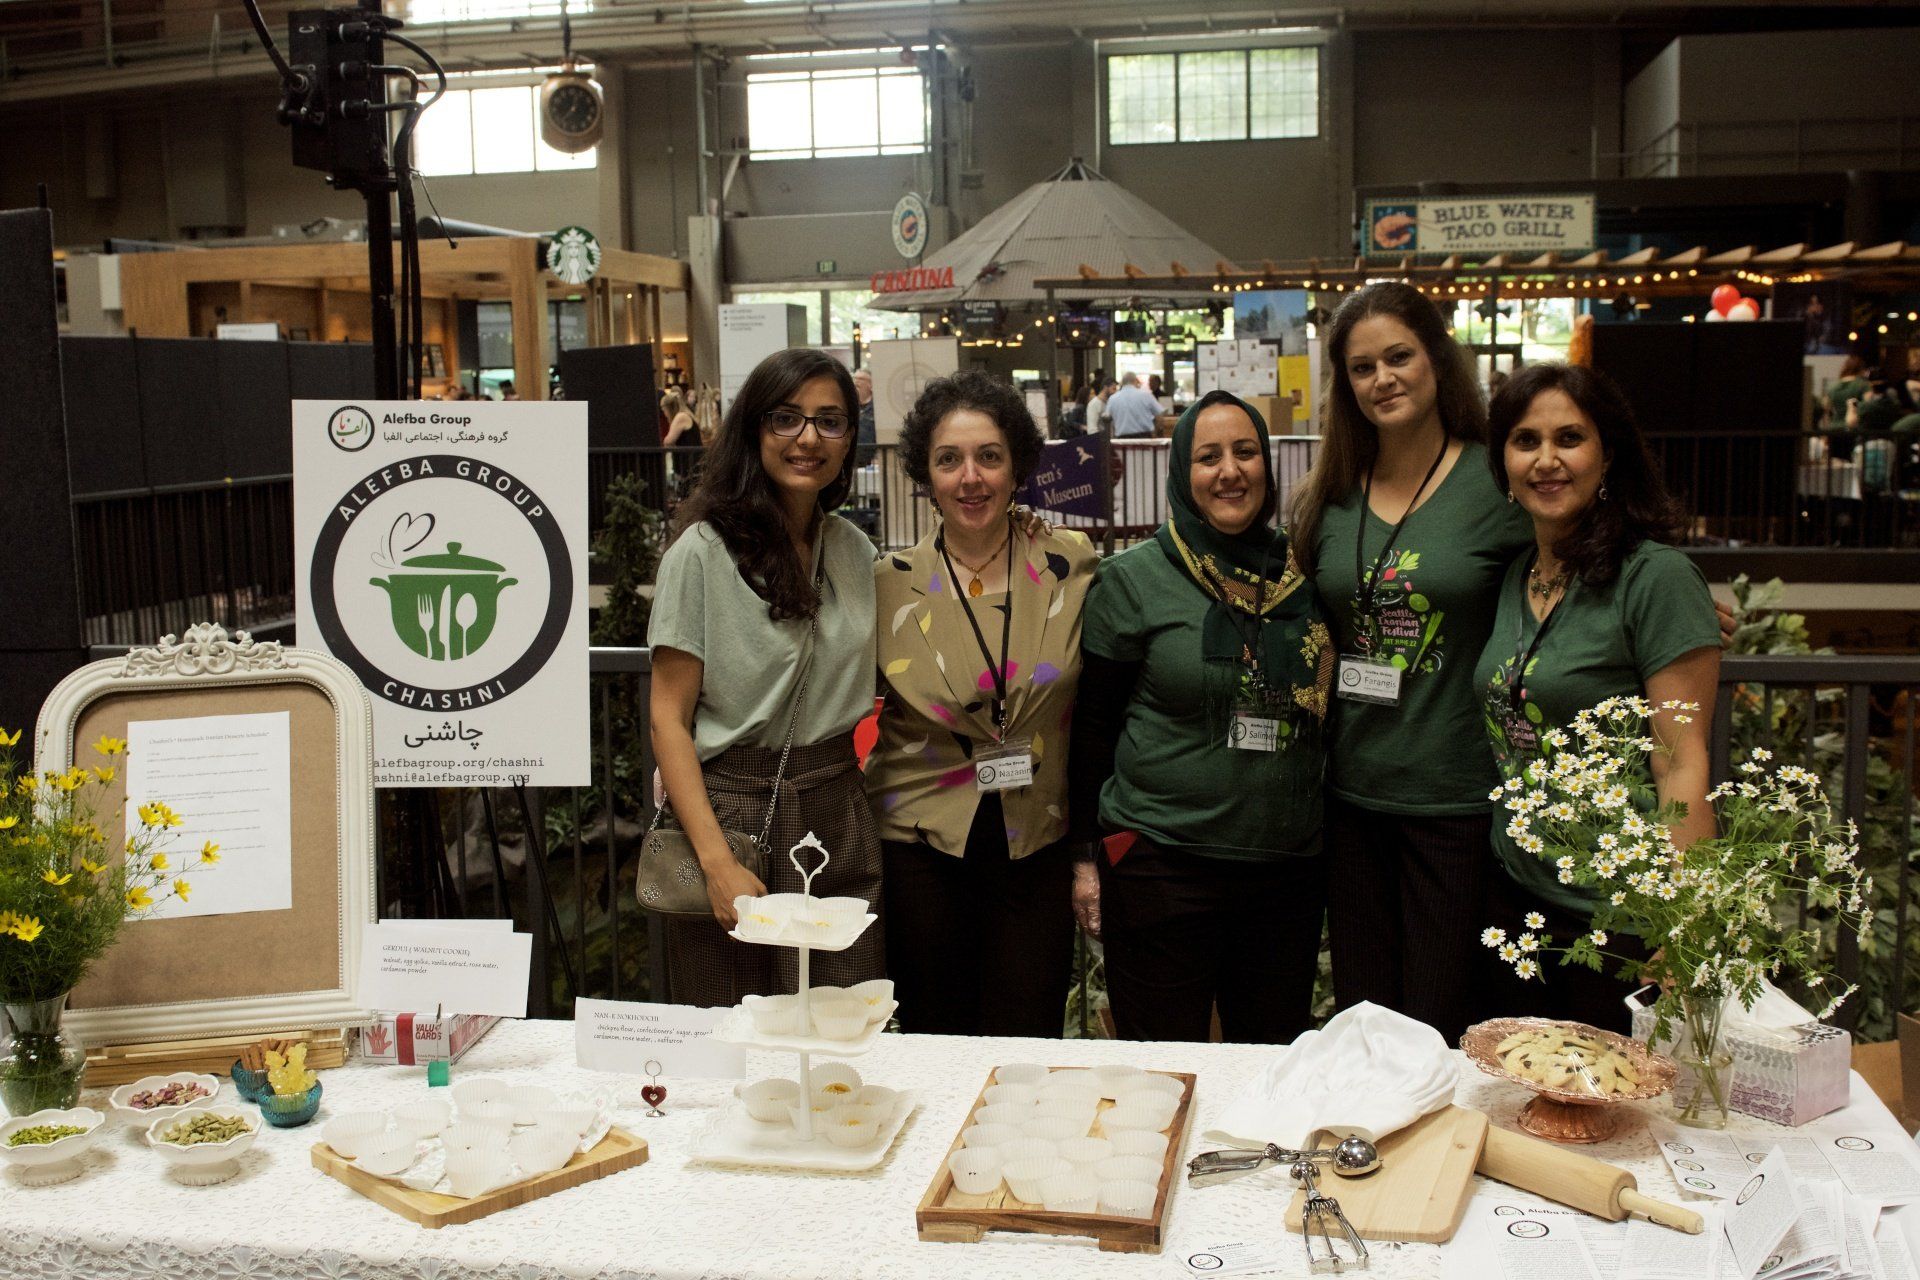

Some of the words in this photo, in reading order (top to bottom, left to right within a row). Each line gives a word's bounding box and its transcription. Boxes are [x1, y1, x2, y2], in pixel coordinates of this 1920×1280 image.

[1434, 204, 1489, 224] BLUE
[1499, 203, 1575, 220] WATER
[1442, 221, 1496, 240] TACO
[1503, 221, 1565, 237] GRILL
[870, 266, 955, 293] CANTINA
[382, 413, 425, 424] Alefba
[430, 414, 471, 426] Group
[382, 431, 402, 441] الفبا
[405, 431, 443, 443] اجتماعی
[487, 431, 509, 444] گروه
[338, 459, 434, 521] ALEFBA
[456, 460, 543, 517] GROUP
[1043, 483, 1093, 507] Museum
[1382, 608, 1415, 618] Seattle
[1376, 616, 1420, 628] Iranian
[1381, 626, 1420, 638] Festival
[1364, 676, 1397, 688] Farangis
[383, 680, 506, 709] CHASHNI
[404, 720, 483, 750] چاشنی
[408, 966, 427, 974] powder
[415, 1032, 442, 1040] GARDS
